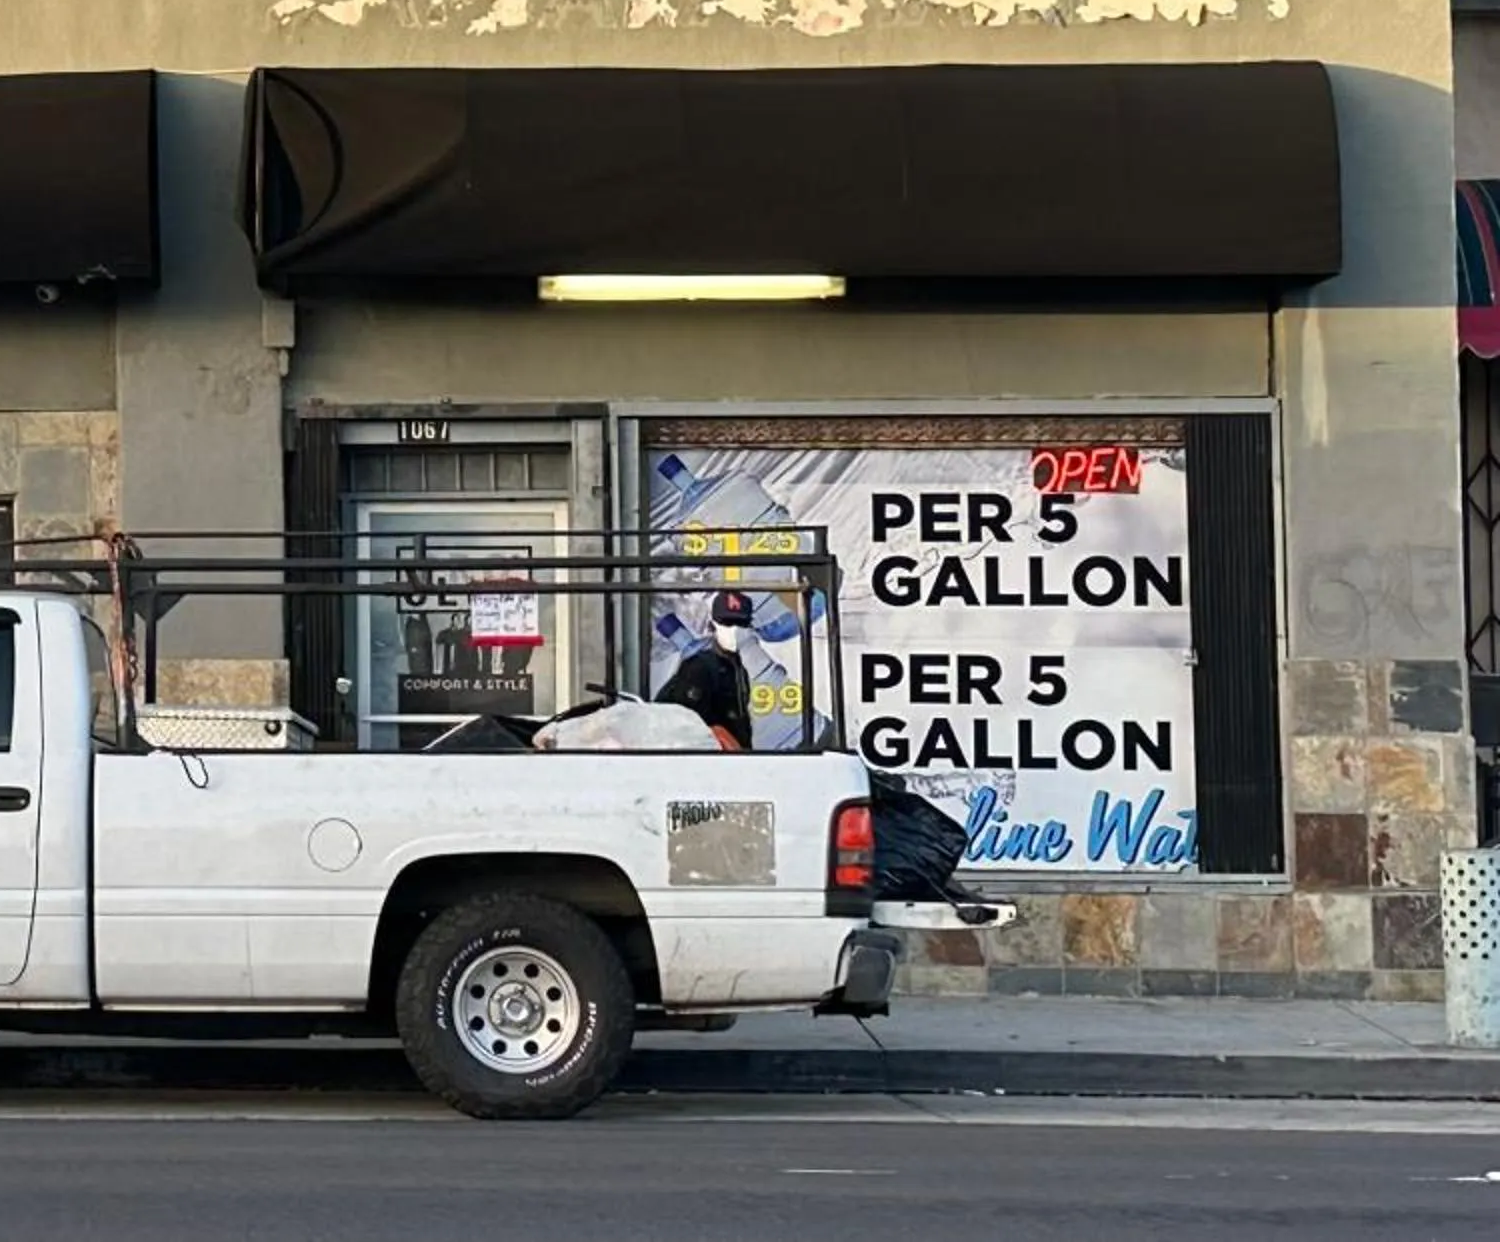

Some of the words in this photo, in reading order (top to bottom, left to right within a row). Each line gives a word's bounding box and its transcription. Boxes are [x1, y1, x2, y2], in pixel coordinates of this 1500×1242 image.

[401, 421, 447, 439] 1067
[1030, 447, 1143, 494] OPEN
[871, 493, 1013, 543] PER
[1038, 494, 1078, 543] 5
[871, 555, 1183, 607] GALLON
[403, 678, 470, 690] COMFORT
[487, 677, 529, 691] STYLE
[861, 654, 1003, 705] PER
[1027, 655, 1067, 706] 5
[860, 715, 1172, 772] GALLON
